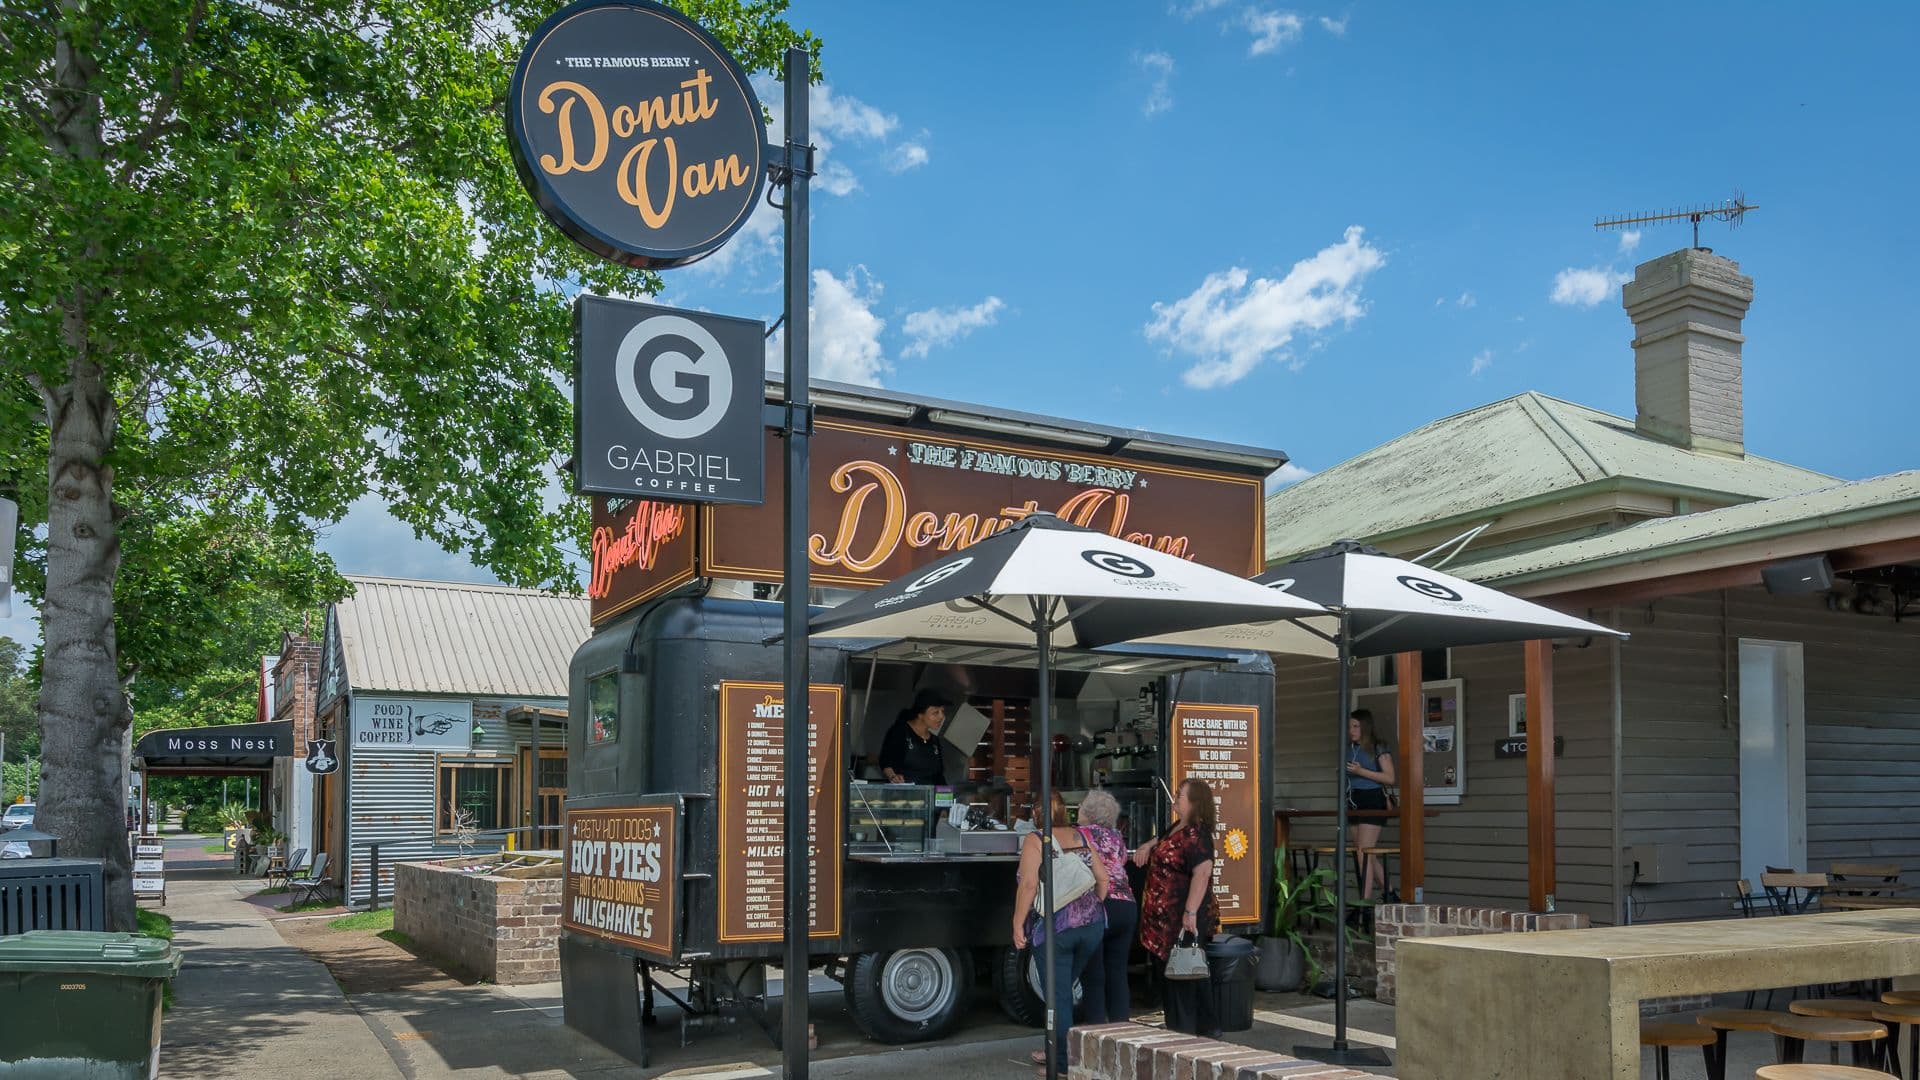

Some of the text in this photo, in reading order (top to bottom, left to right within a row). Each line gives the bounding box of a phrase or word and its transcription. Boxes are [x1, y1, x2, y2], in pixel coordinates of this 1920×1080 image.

[565, 57, 691, 68] THE FAMOUS BERRY
[538, 69, 719, 175] Donut
[616, 136, 750, 229] Van
[607, 445, 741, 482] GABRIEL
[908, 442, 1137, 490] THE FAMOUS BERRY
[635, 477, 716, 493] COFFEE
[374, 704, 403, 716] FOOD
[371, 717, 403, 729] WINE
[1183, 718, 1248, 730] PLEASE BARE WITH US
[169, 738, 274, 750] Moss Nest
[360, 731, 403, 743] COFFEE
[1199, 750, 1232, 761] WE DO NOT
[748, 785, 770, 797] HOT
[577, 818, 652, 841] TASTY HOT DOGS
[571, 840, 661, 883] HOT PIES
[579, 876, 591, 895] HOT
[598, 878, 614, 900] COLD
[615, 880, 645, 905] DRINKS
[573, 896, 654, 939] MILKSHAKES
